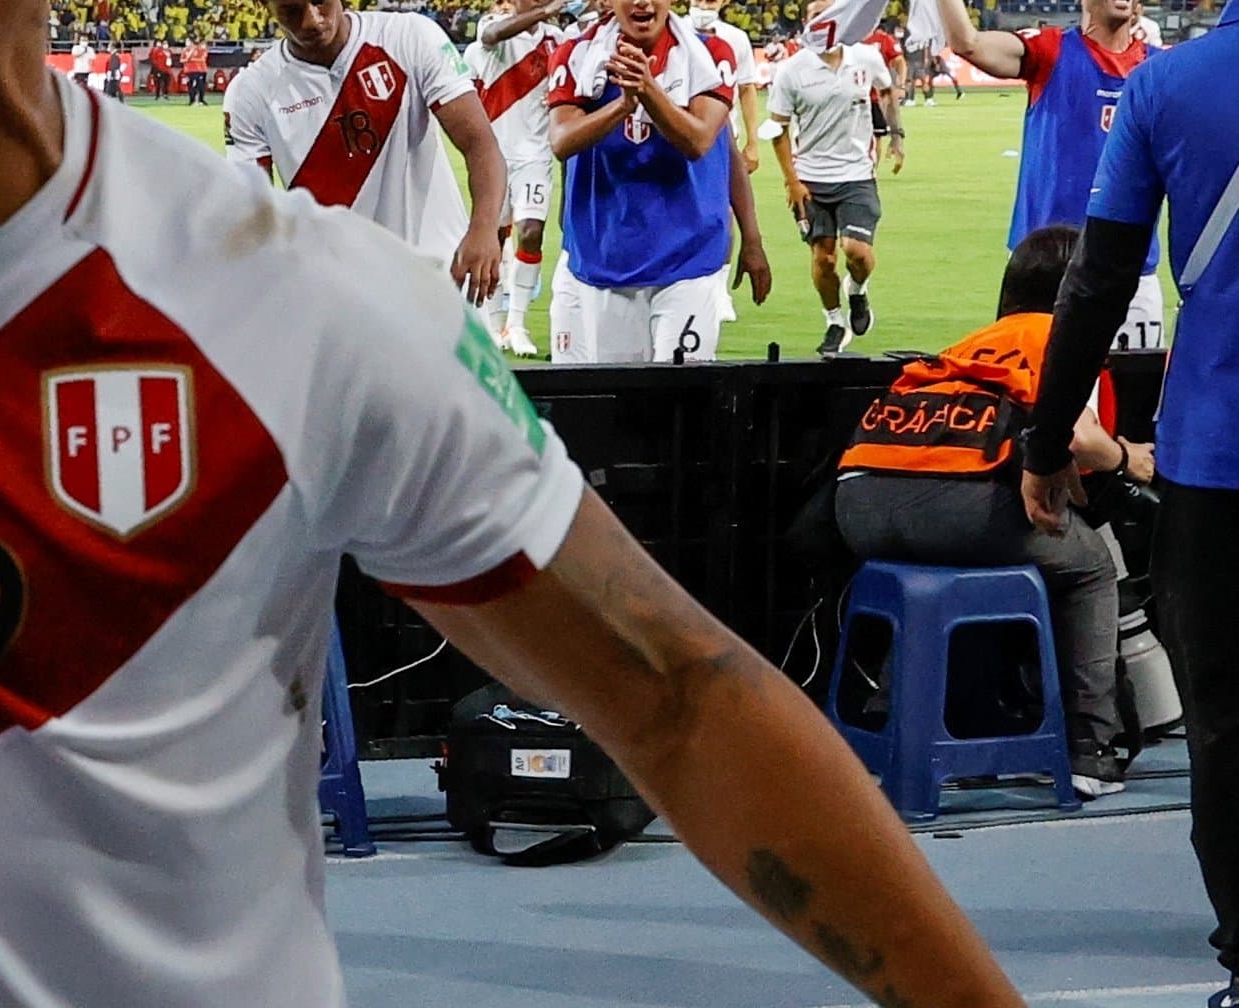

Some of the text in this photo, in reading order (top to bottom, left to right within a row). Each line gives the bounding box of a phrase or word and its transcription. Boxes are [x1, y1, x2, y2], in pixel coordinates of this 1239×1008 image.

[525, 183, 545, 204] 15
[679, 314, 700, 353] 6
[1135, 320, 1162, 348] 17
